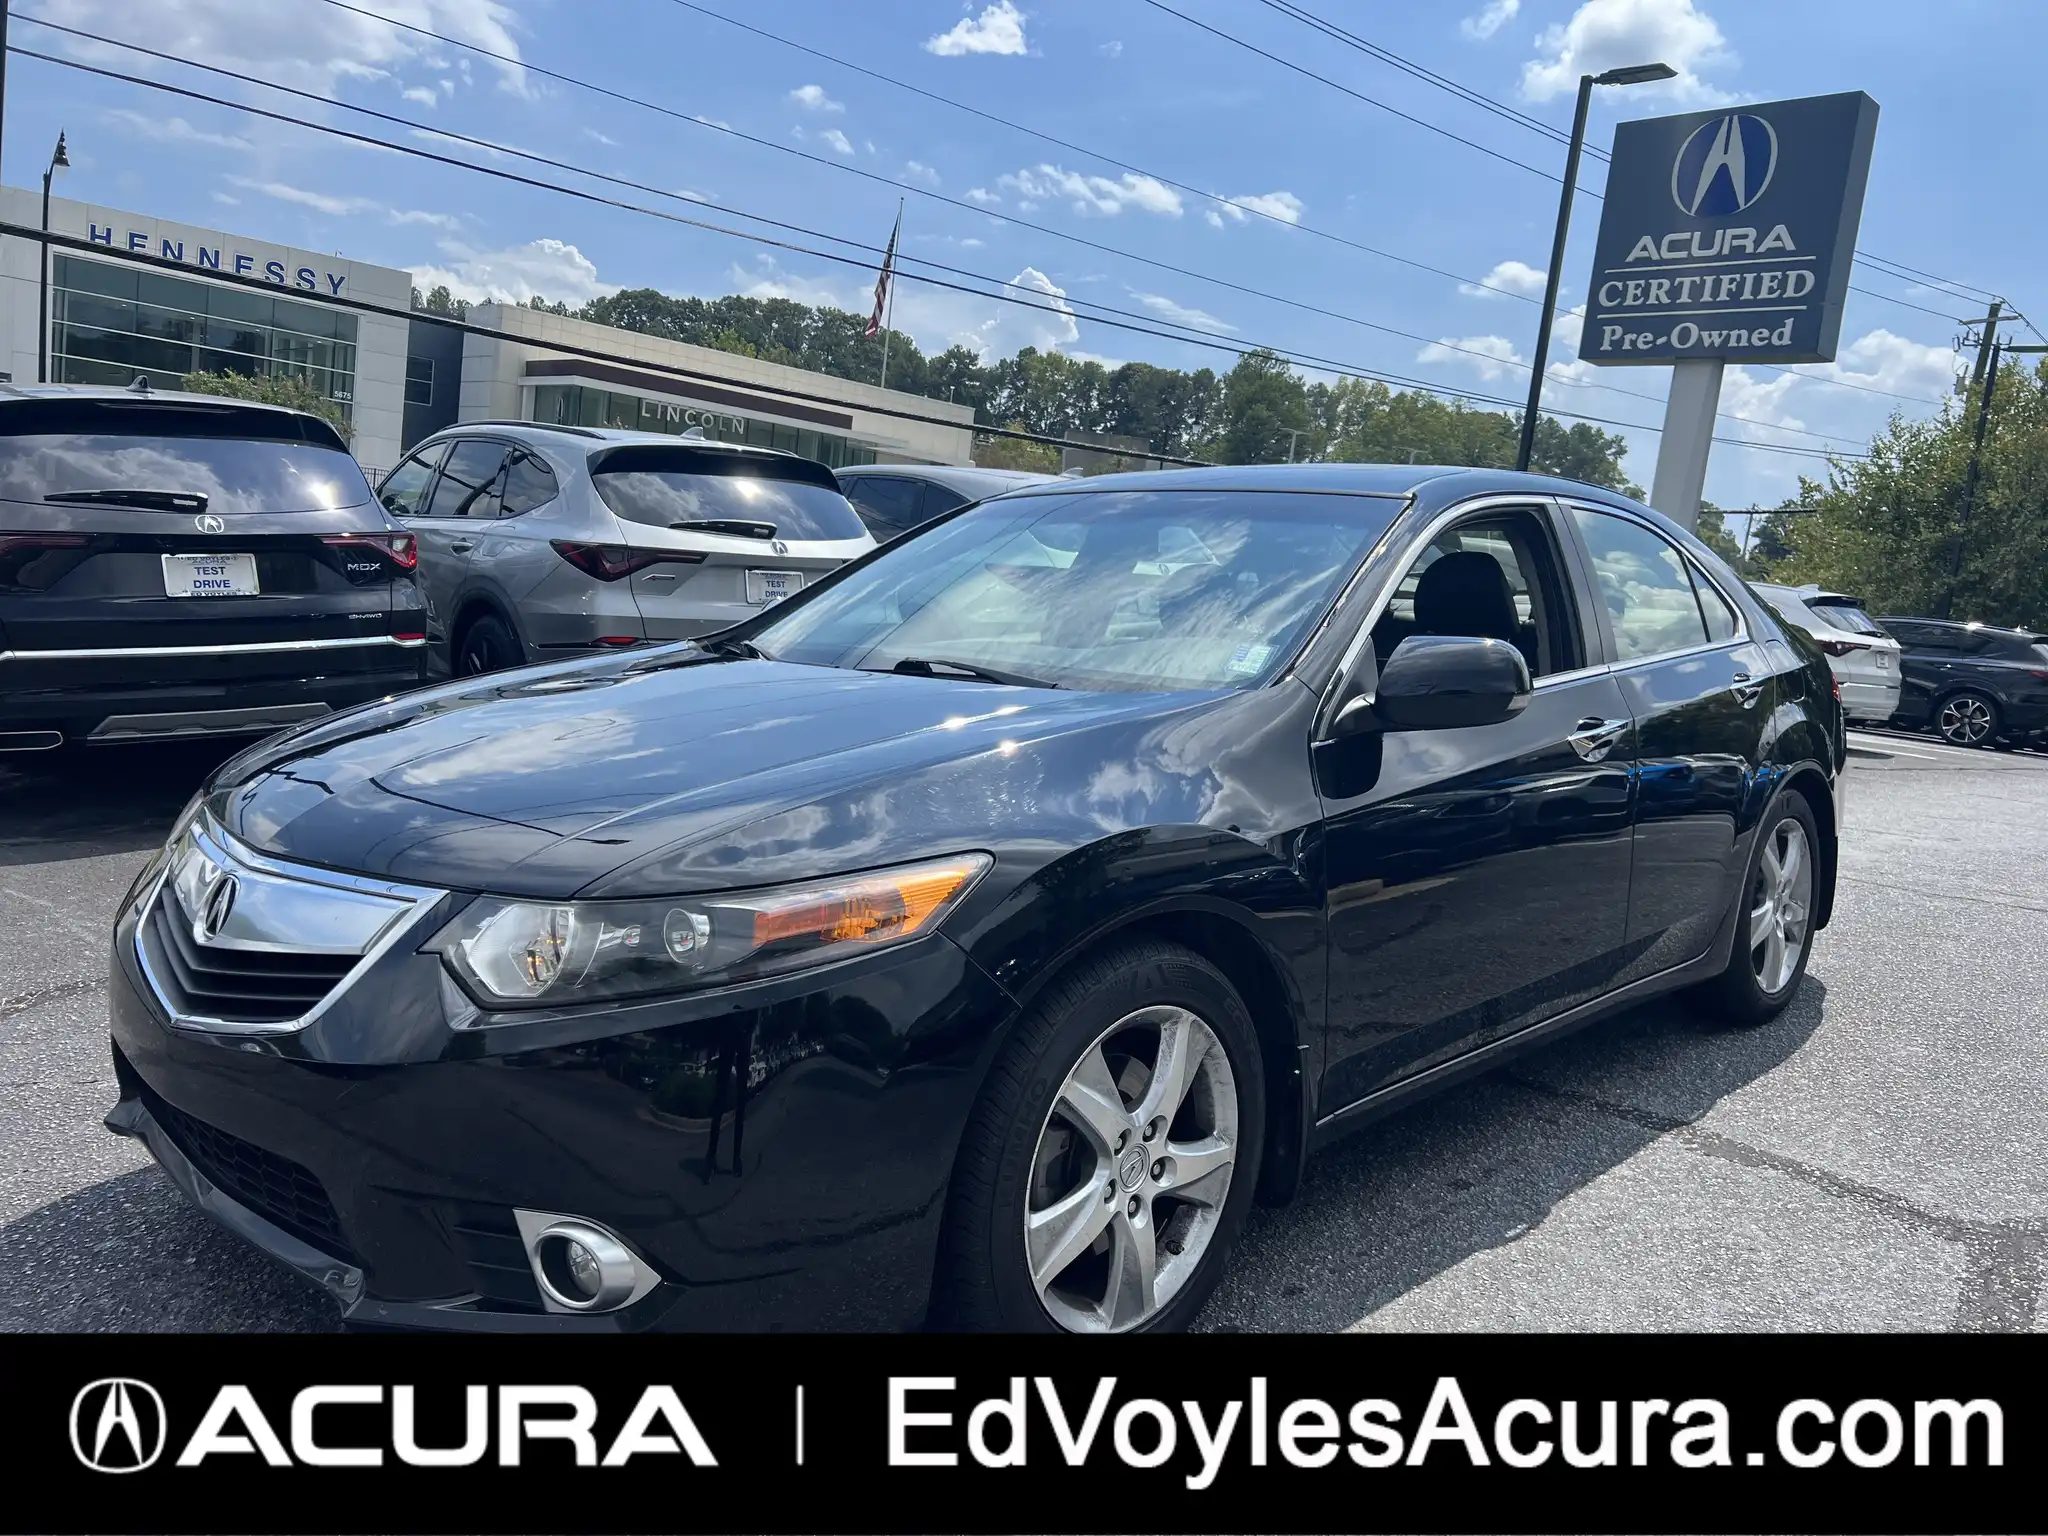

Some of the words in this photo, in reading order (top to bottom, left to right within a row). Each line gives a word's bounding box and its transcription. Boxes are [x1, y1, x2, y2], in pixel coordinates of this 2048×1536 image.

[1625, 224, 1796, 262] ACURA
[88, 223, 347, 296] HENNESSY
[1598, 270, 1816, 307] CERTIFIED
[1600, 318, 1795, 351] Pre-Owned
[334, 390, 352, 400] 5675
[642, 399, 745, 434] LINCOLN
[194, 567, 226, 576] TEST
[347, 563, 381, 571] MDX
[193, 580, 231, 589] DRIVE
[766, 580, 786, 588] TEST
[765, 590, 788, 598] DRIVE
